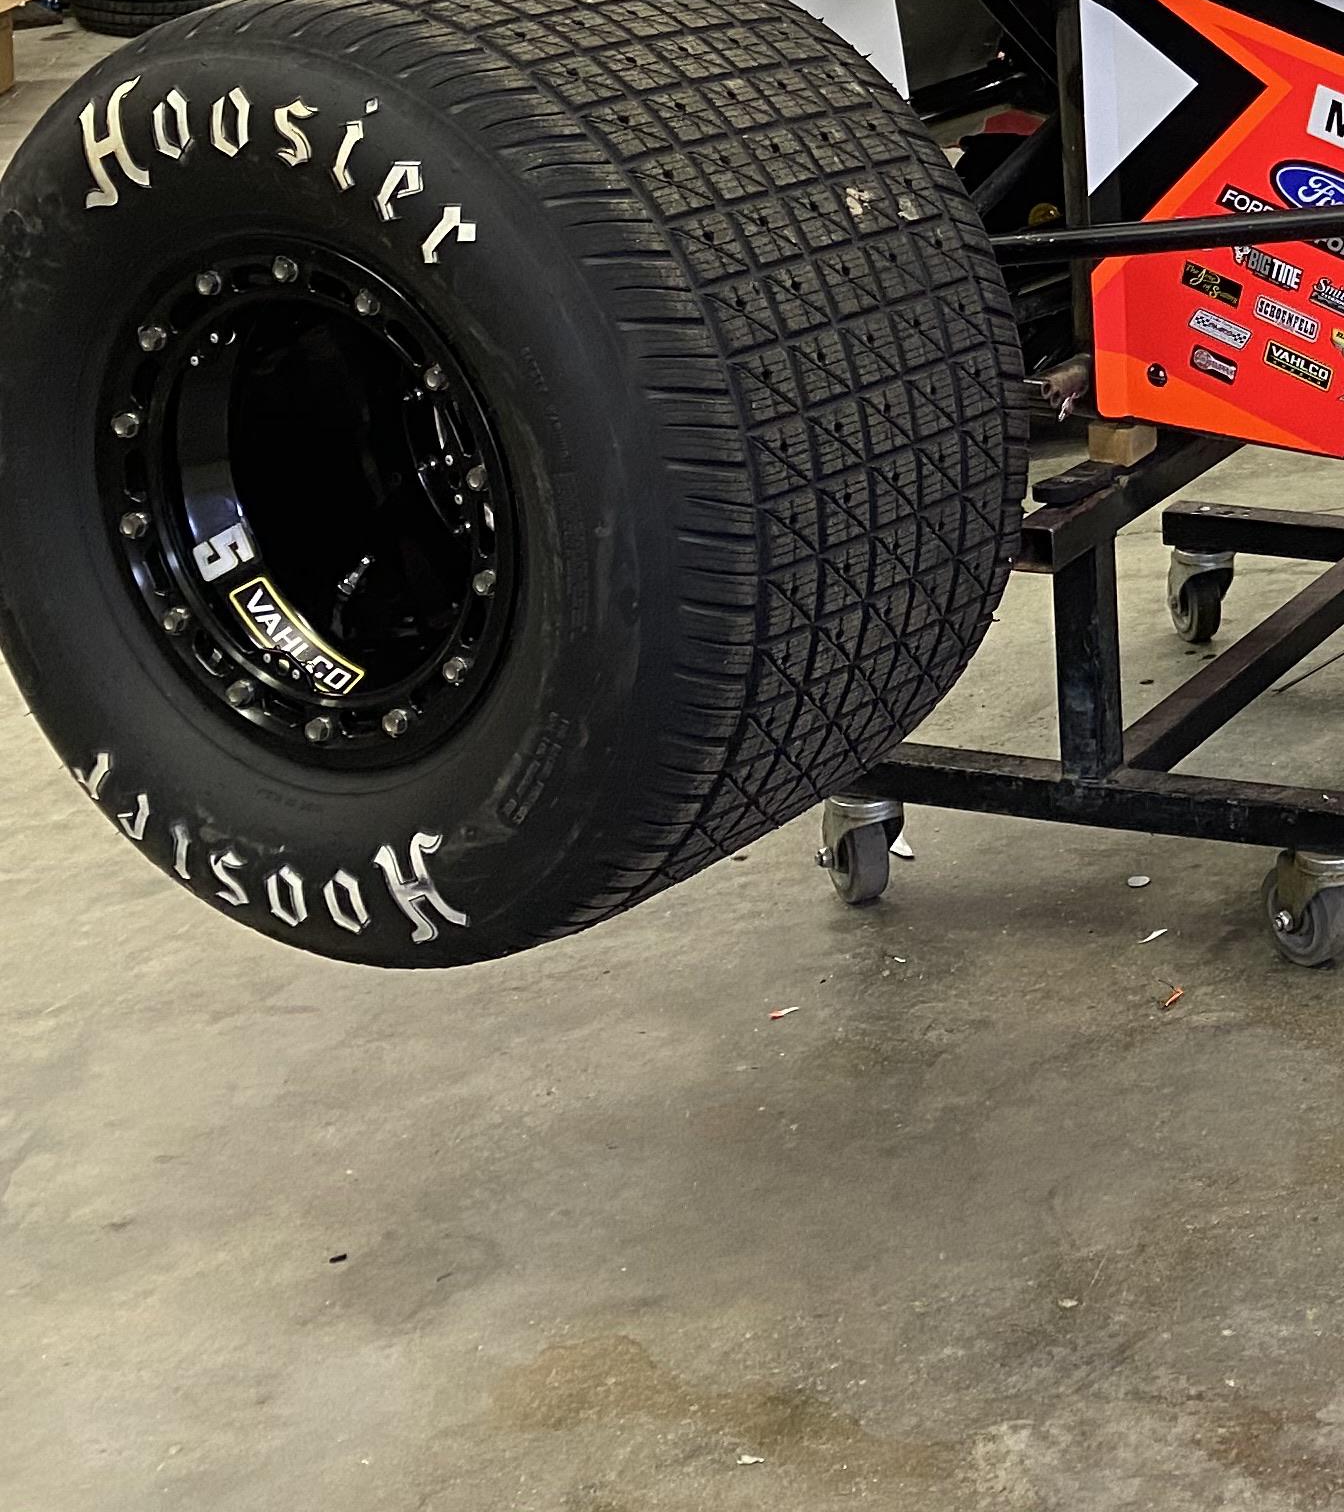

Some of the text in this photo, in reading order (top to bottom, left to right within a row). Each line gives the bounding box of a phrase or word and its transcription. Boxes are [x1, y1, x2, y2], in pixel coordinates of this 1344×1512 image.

[78, 75, 477, 264] Hoosier
[1222, 189, 1275, 214] FOR
[1271, 345, 1330, 381] VAHLCO
